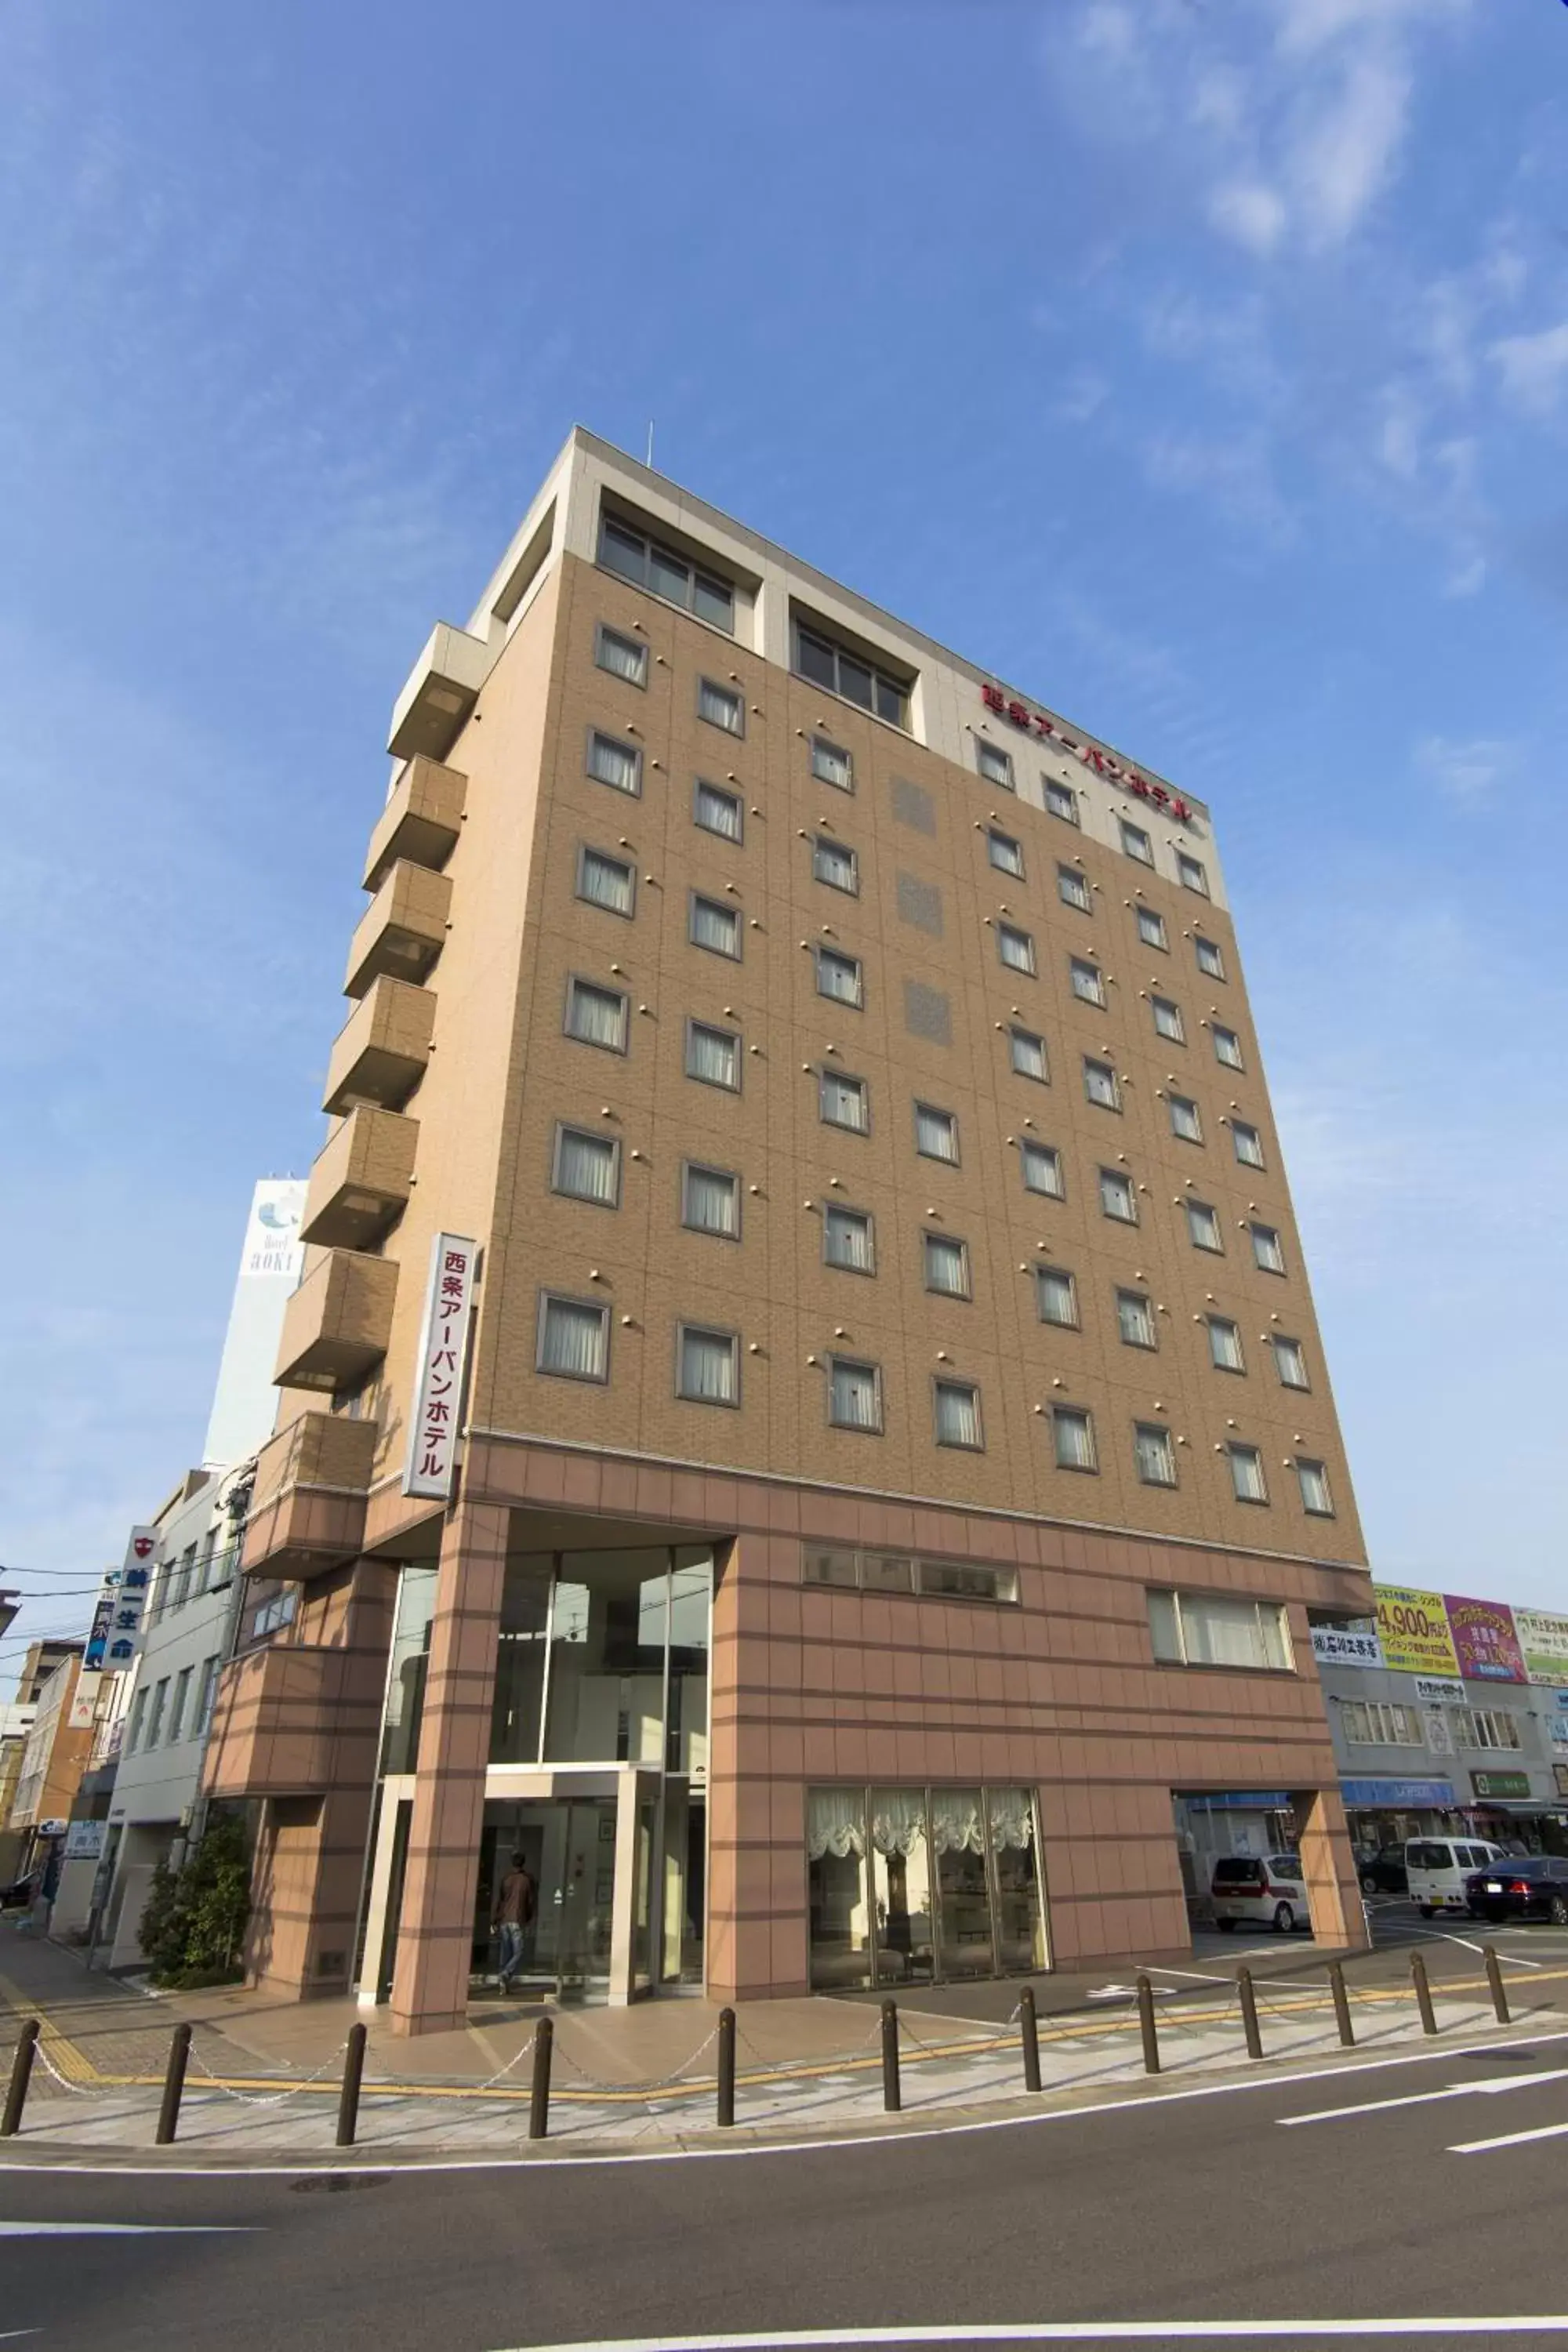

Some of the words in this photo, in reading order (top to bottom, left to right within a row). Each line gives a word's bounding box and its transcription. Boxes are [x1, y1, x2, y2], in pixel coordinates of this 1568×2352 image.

[419, 1250, 466, 1478] 西条アーバンホテル
